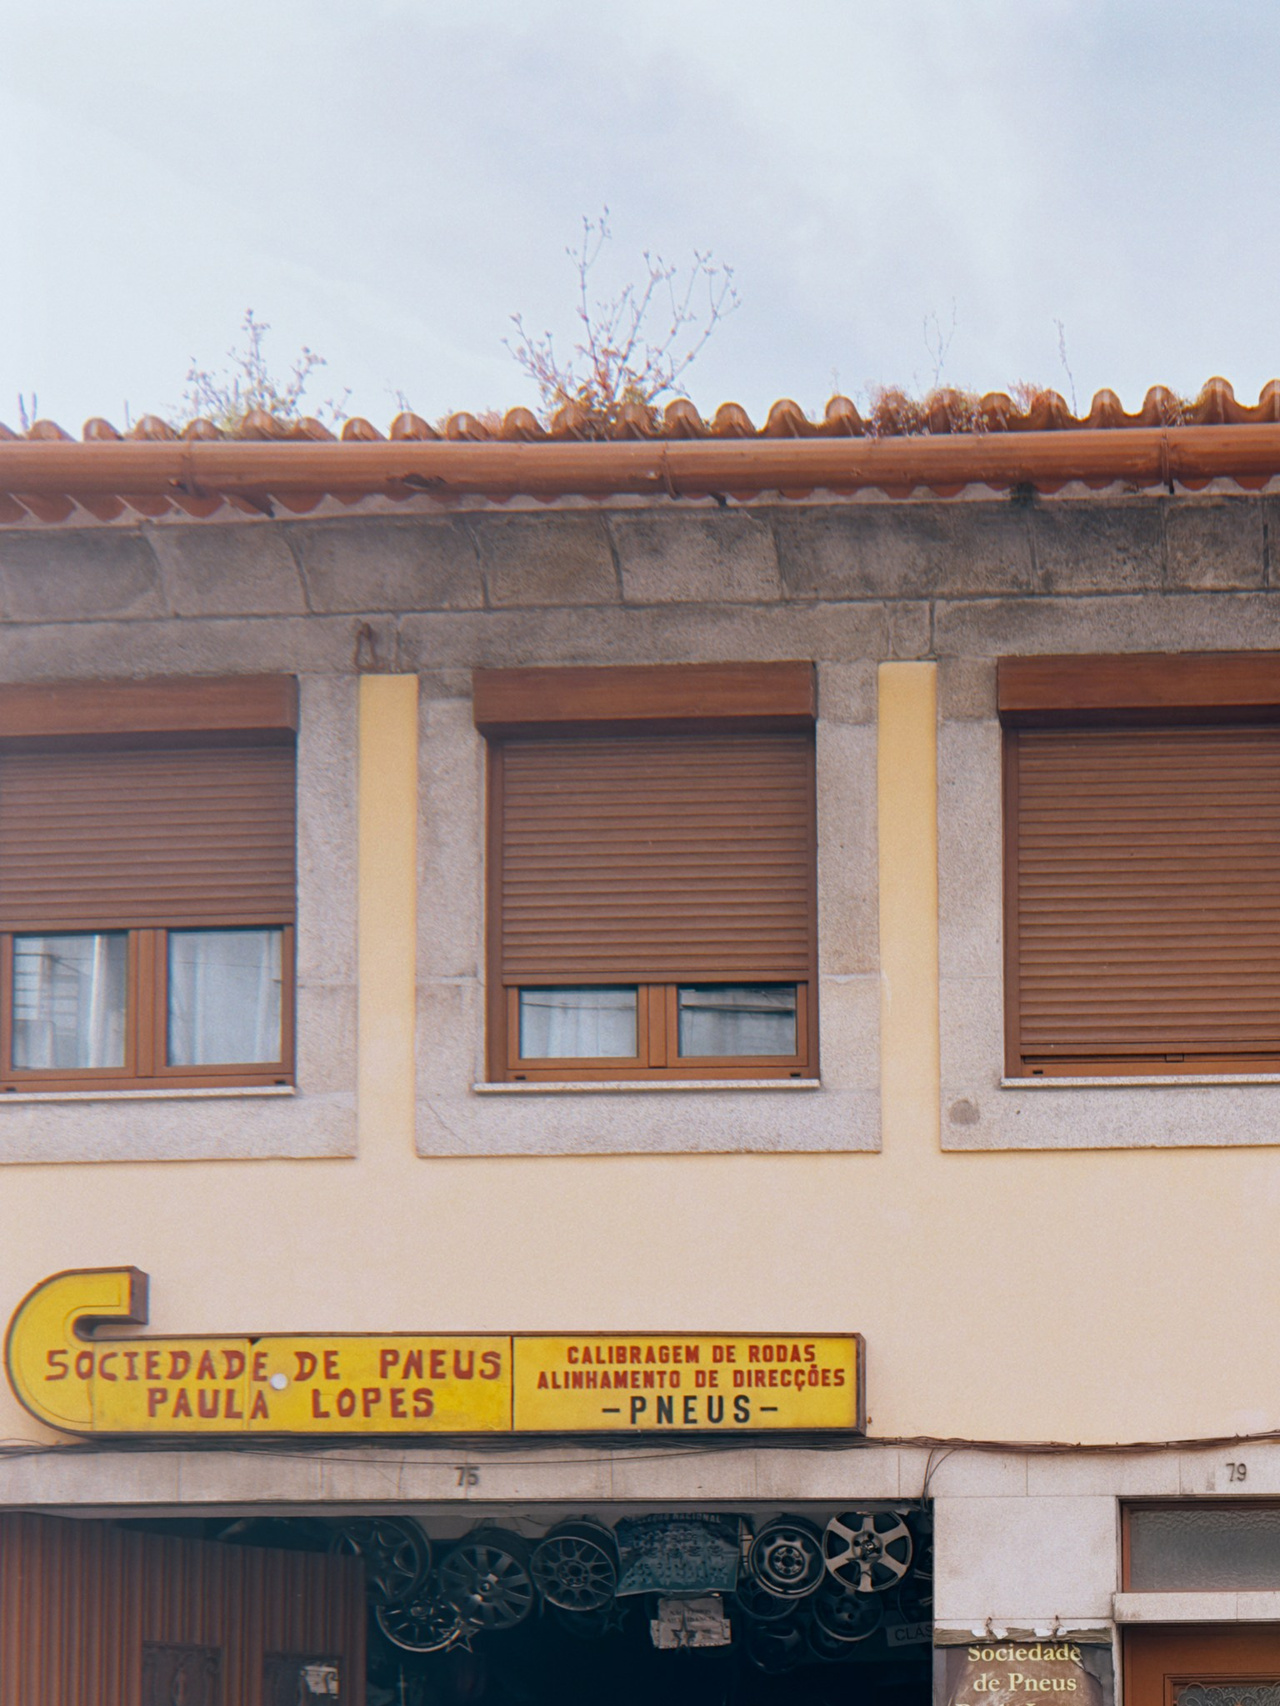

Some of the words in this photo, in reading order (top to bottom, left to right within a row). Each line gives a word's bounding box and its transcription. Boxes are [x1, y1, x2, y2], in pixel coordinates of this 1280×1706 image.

[567, 1345, 700, 1364] CALIBRAGEM
[712, 1345, 736, 1364] DE
[748, 1344, 816, 1363] RODAS
[45, 1350, 269, 1382] SOCIEDADE
[294, 1350, 340, 1381] DE
[379, 1349, 501, 1380] PNEUS
[537, 1370, 681, 1389] ALINHAMENTO
[695, 1369, 719, 1388] DE
[733, 1364, 845, 1391] DIRECÇÕES
[148, 1388, 269, 1419] PAULA
[312, 1388, 434, 1419] LOPES
[454, 1466, 480, 1486] 75
[1226, 1463, 1247, 1482] 79
[967, 1644, 1081, 1662] Sociedade
[973, 1673, 1000, 1692] de
[1008, 1673, 1077, 1691] Pneus
